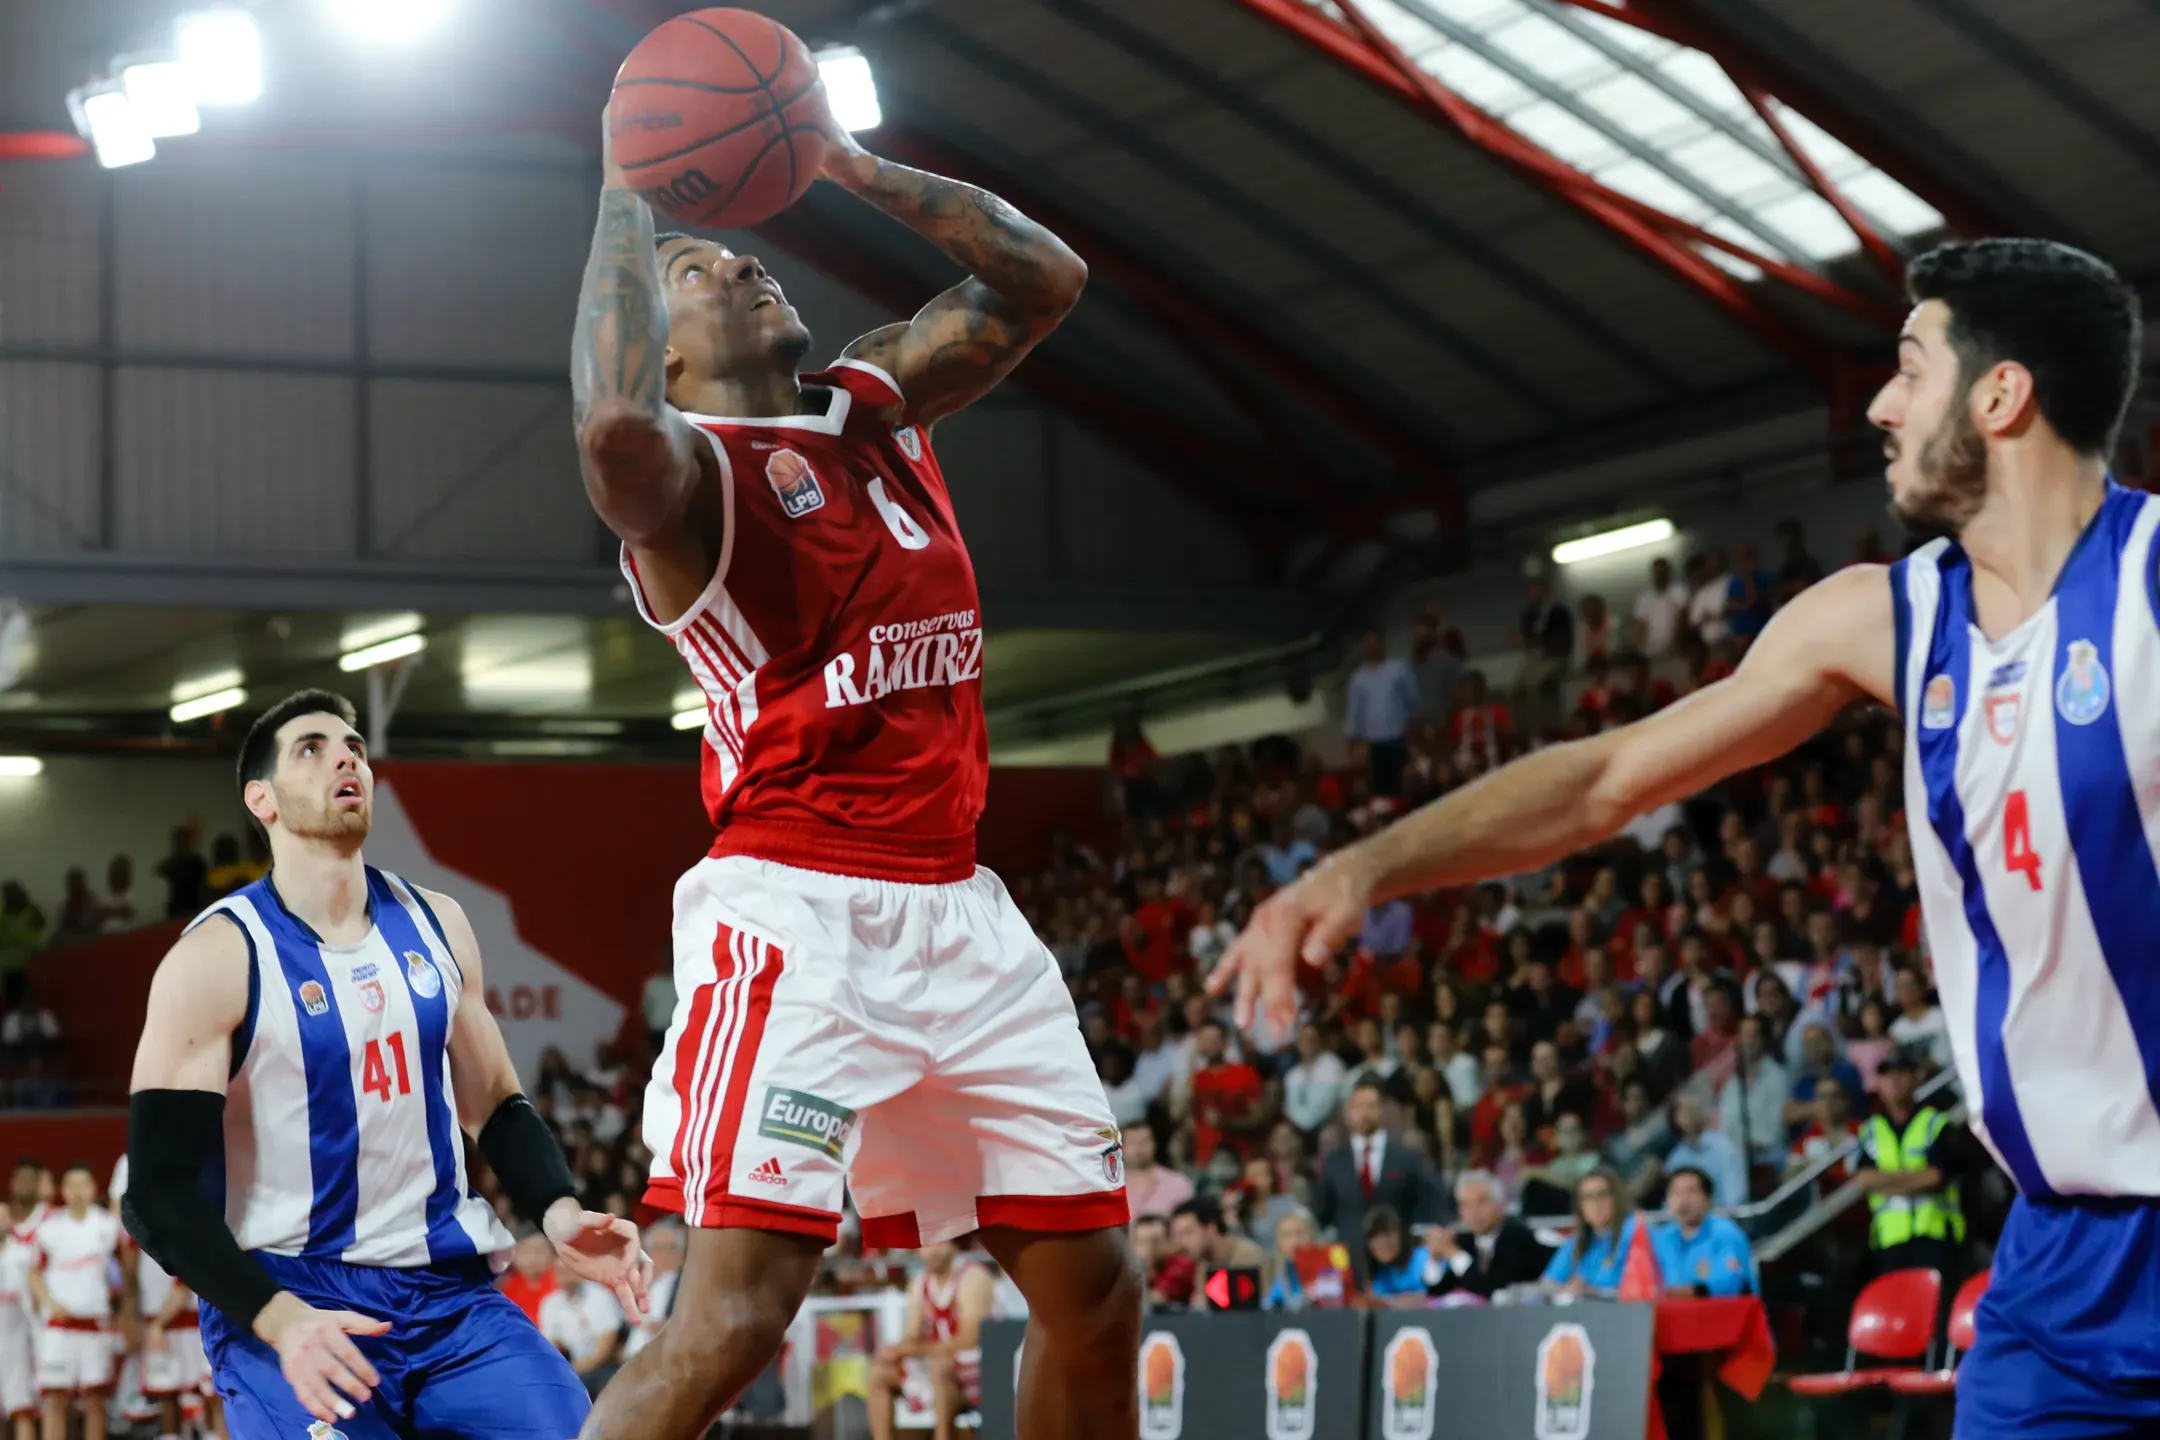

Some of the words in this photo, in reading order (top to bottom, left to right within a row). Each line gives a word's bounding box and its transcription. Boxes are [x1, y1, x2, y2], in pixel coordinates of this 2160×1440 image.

[787, 490, 820, 513] LPB
[867, 476, 931, 550] 6
[869, 609, 975, 644] conservas
[823, 627, 983, 709] RAMIREZ
[2003, 789, 2044, 892] 4
[363, 1031, 412, 1103] 41
[748, 1173, 788, 1185] adidas
